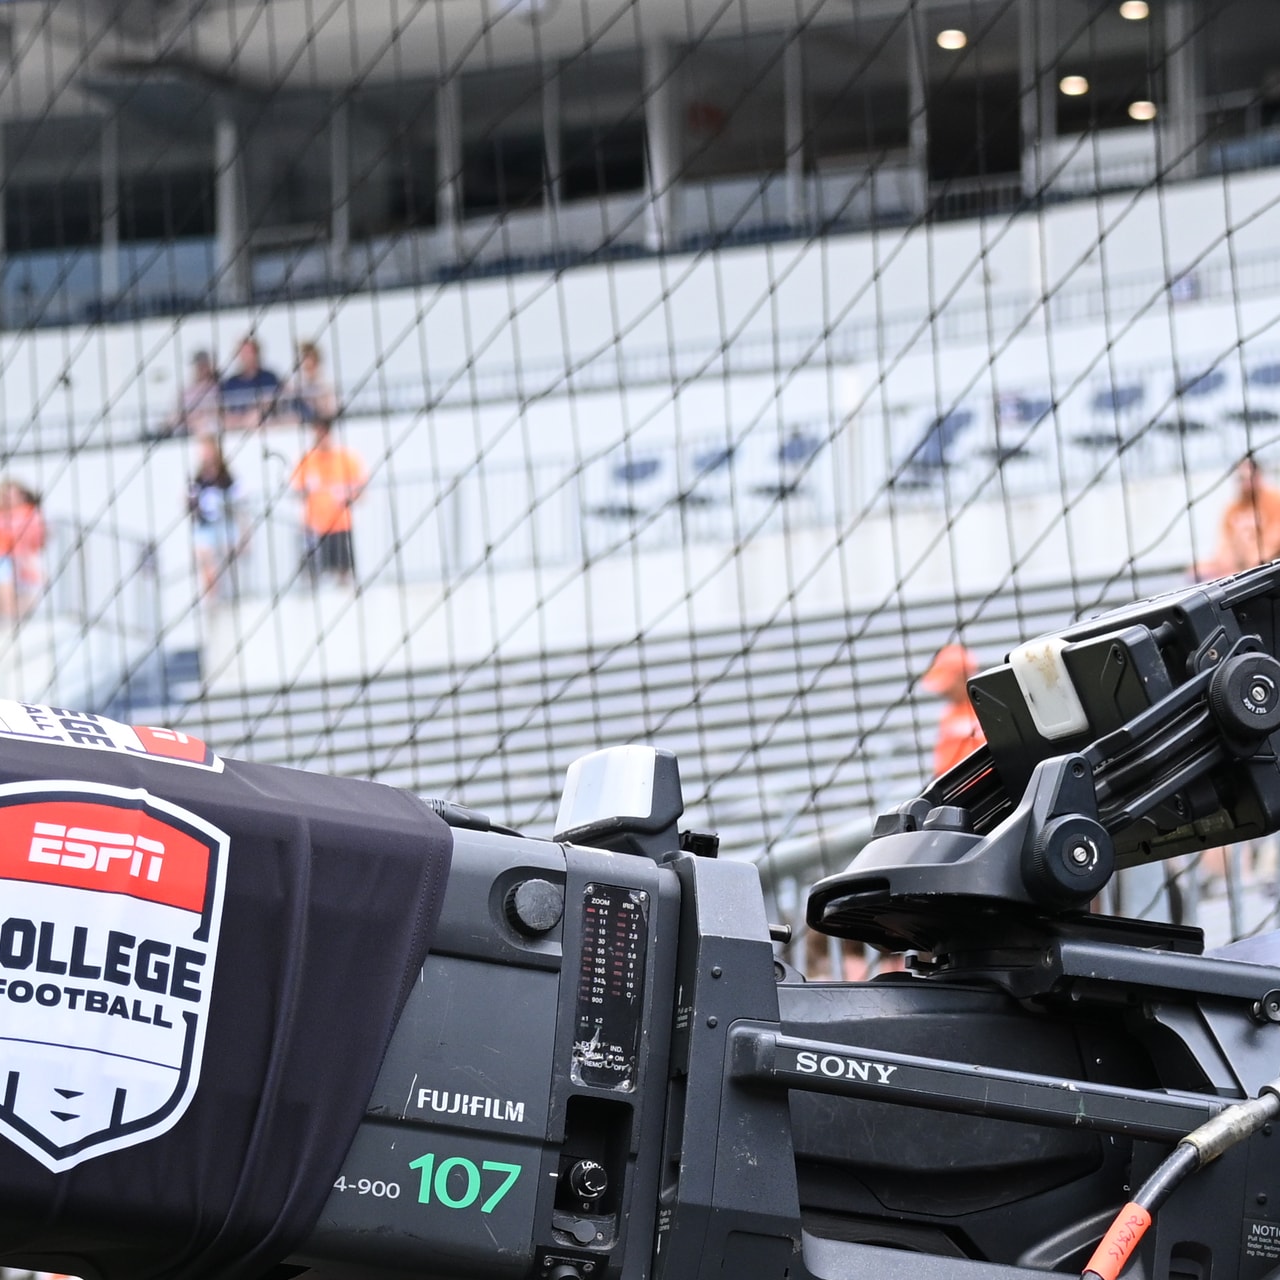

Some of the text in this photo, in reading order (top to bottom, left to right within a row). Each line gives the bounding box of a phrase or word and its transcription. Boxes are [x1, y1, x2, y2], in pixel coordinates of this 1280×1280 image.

[27, 821, 166, 883] ESPN
[591, 897, 610, 906] ZOOM
[796, 1052, 898, 1084] SONY
[417, 1088, 525, 1122] FUJIFILM
[408, 1153, 522, 1214] 107
